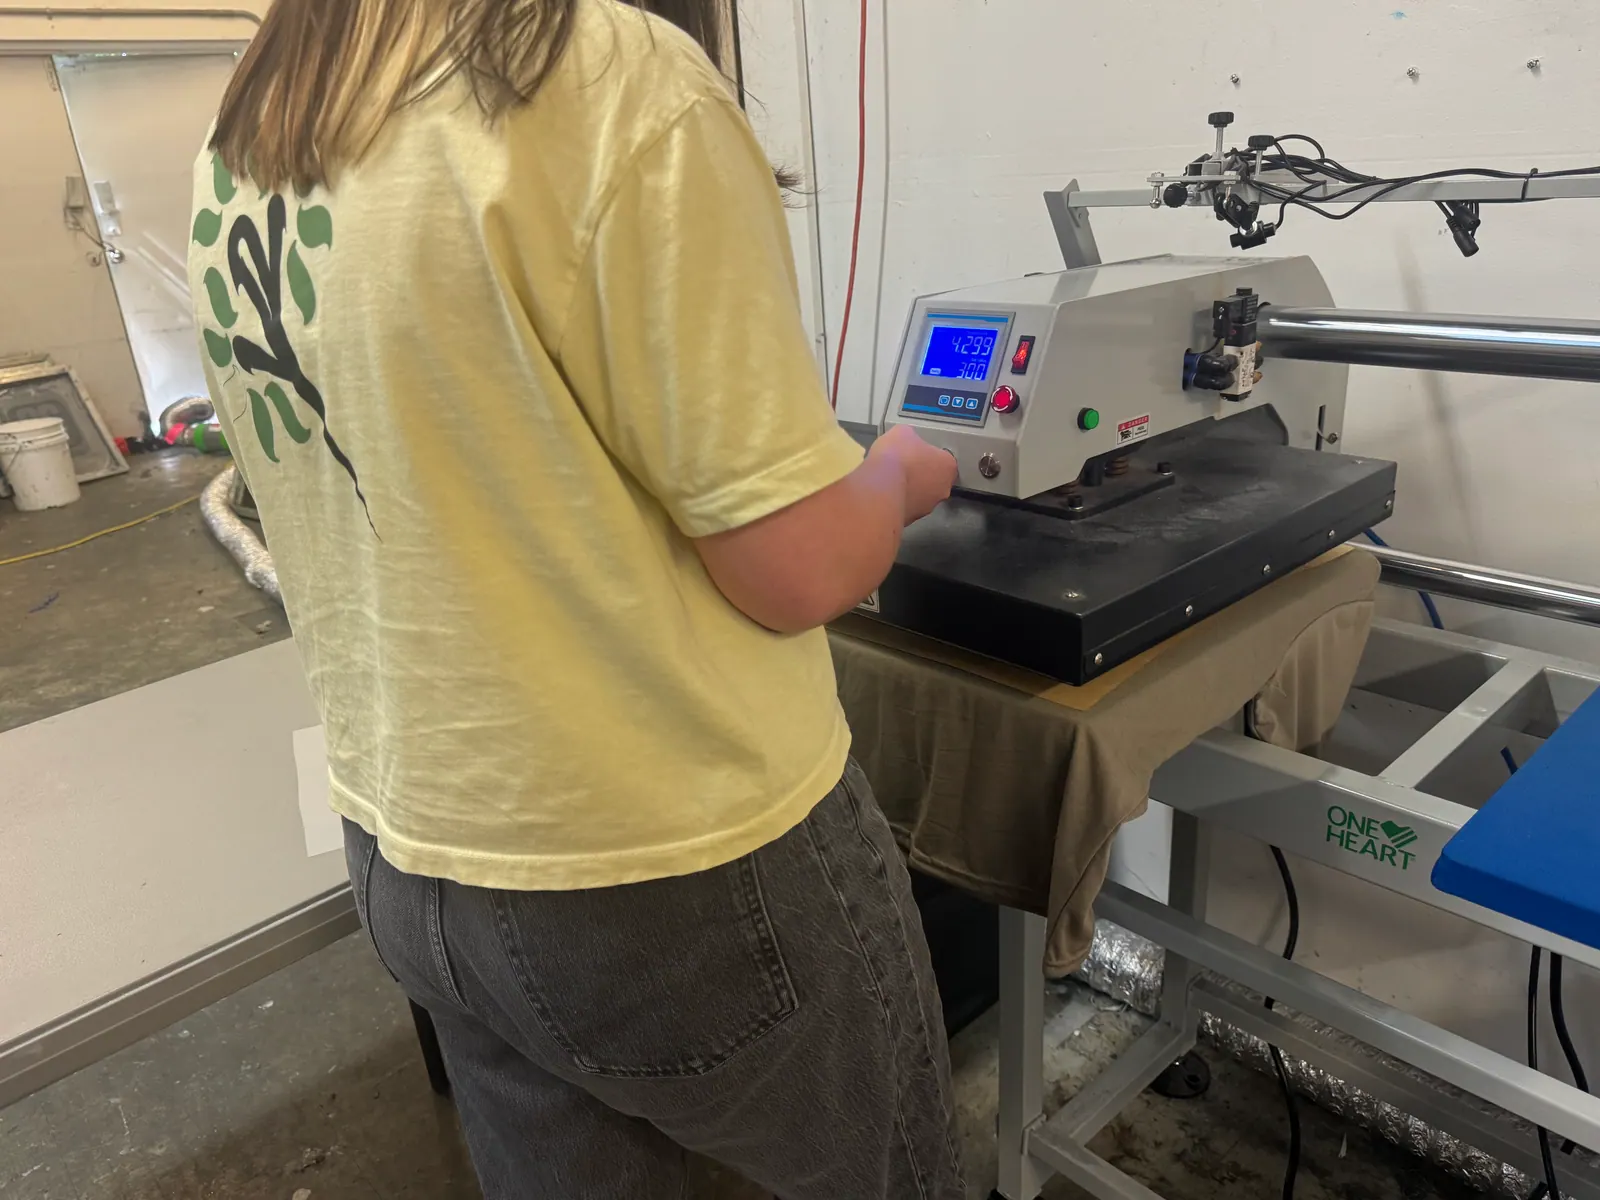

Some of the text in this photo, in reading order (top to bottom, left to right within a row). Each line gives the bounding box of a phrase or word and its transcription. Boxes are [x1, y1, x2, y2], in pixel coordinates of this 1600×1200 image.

[956, 362, 986, 380] 300
[1127, 416, 1148, 428] DANGER
[1327, 806, 1380, 840] ONE
[1326, 825, 1416, 870] HEART
